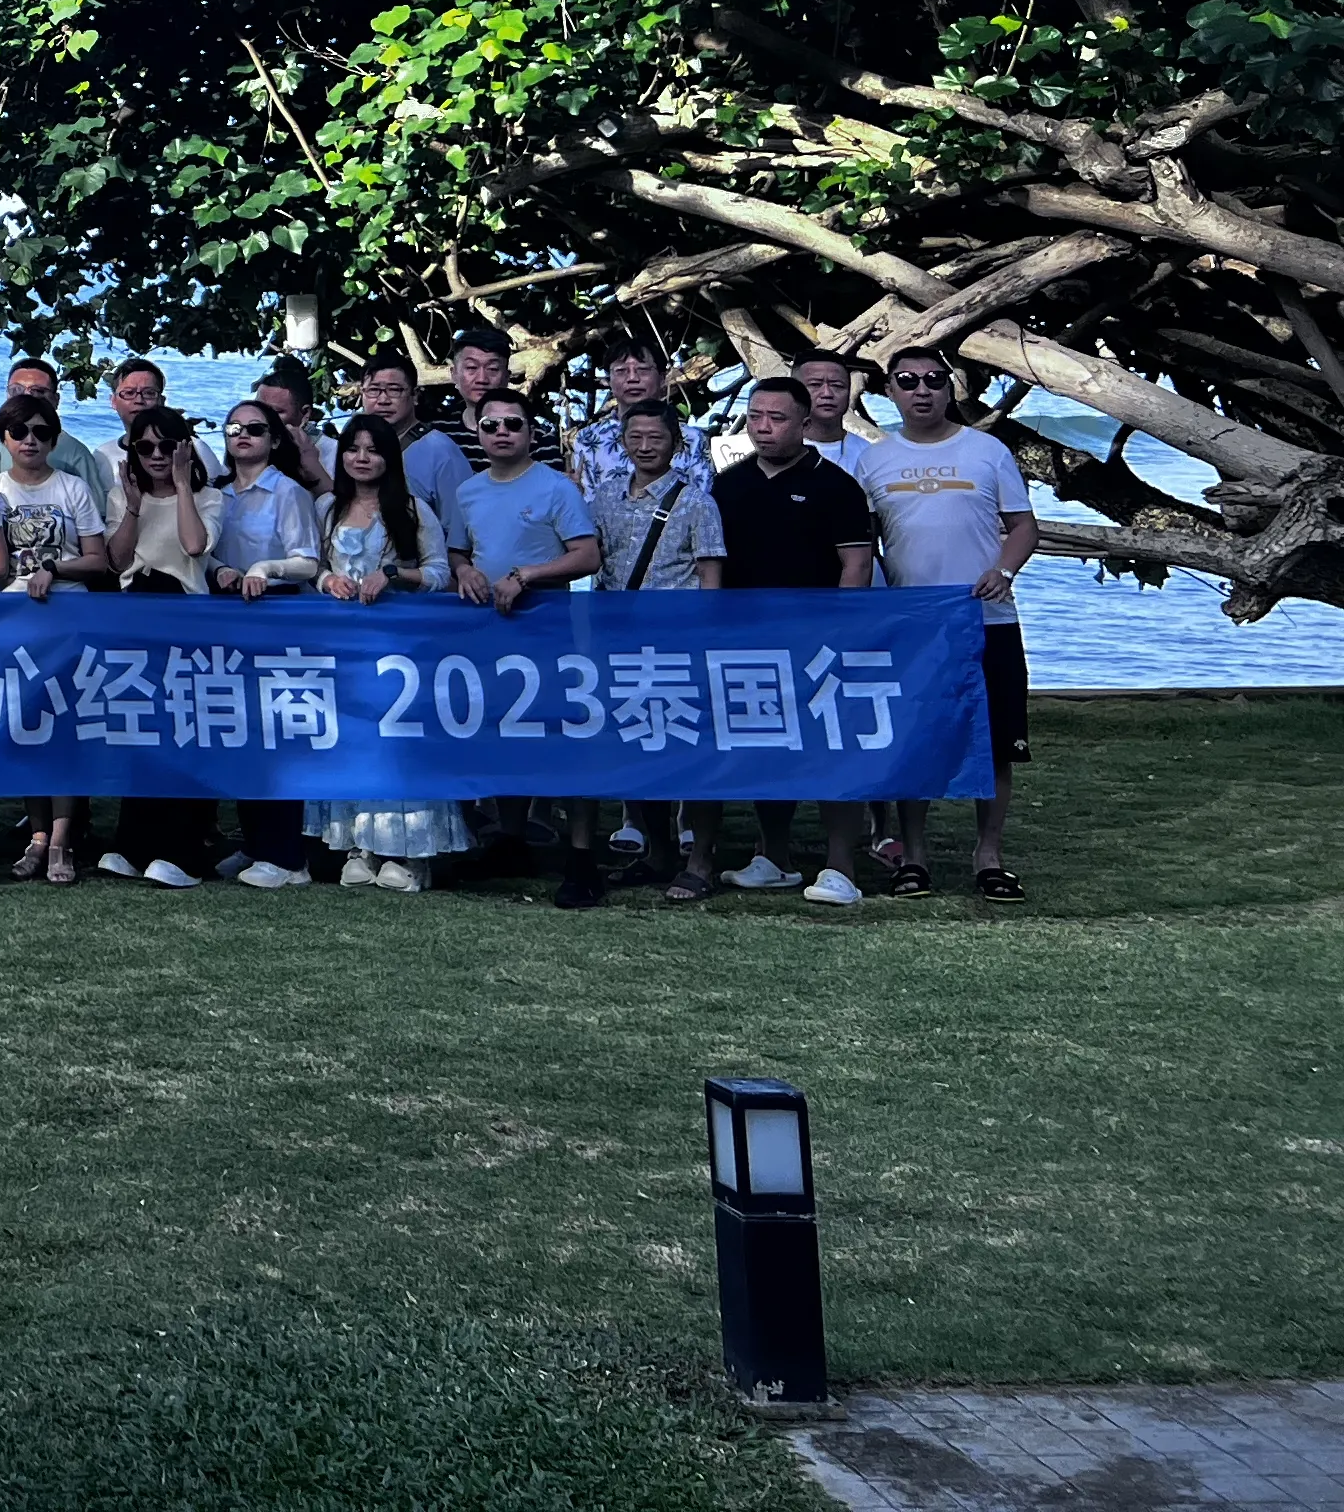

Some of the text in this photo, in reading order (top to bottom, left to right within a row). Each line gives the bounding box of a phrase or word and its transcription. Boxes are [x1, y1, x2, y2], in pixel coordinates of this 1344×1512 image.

[900, 466, 957, 479] GUCCI
[375, 645, 903, 752] 2023泰国行
